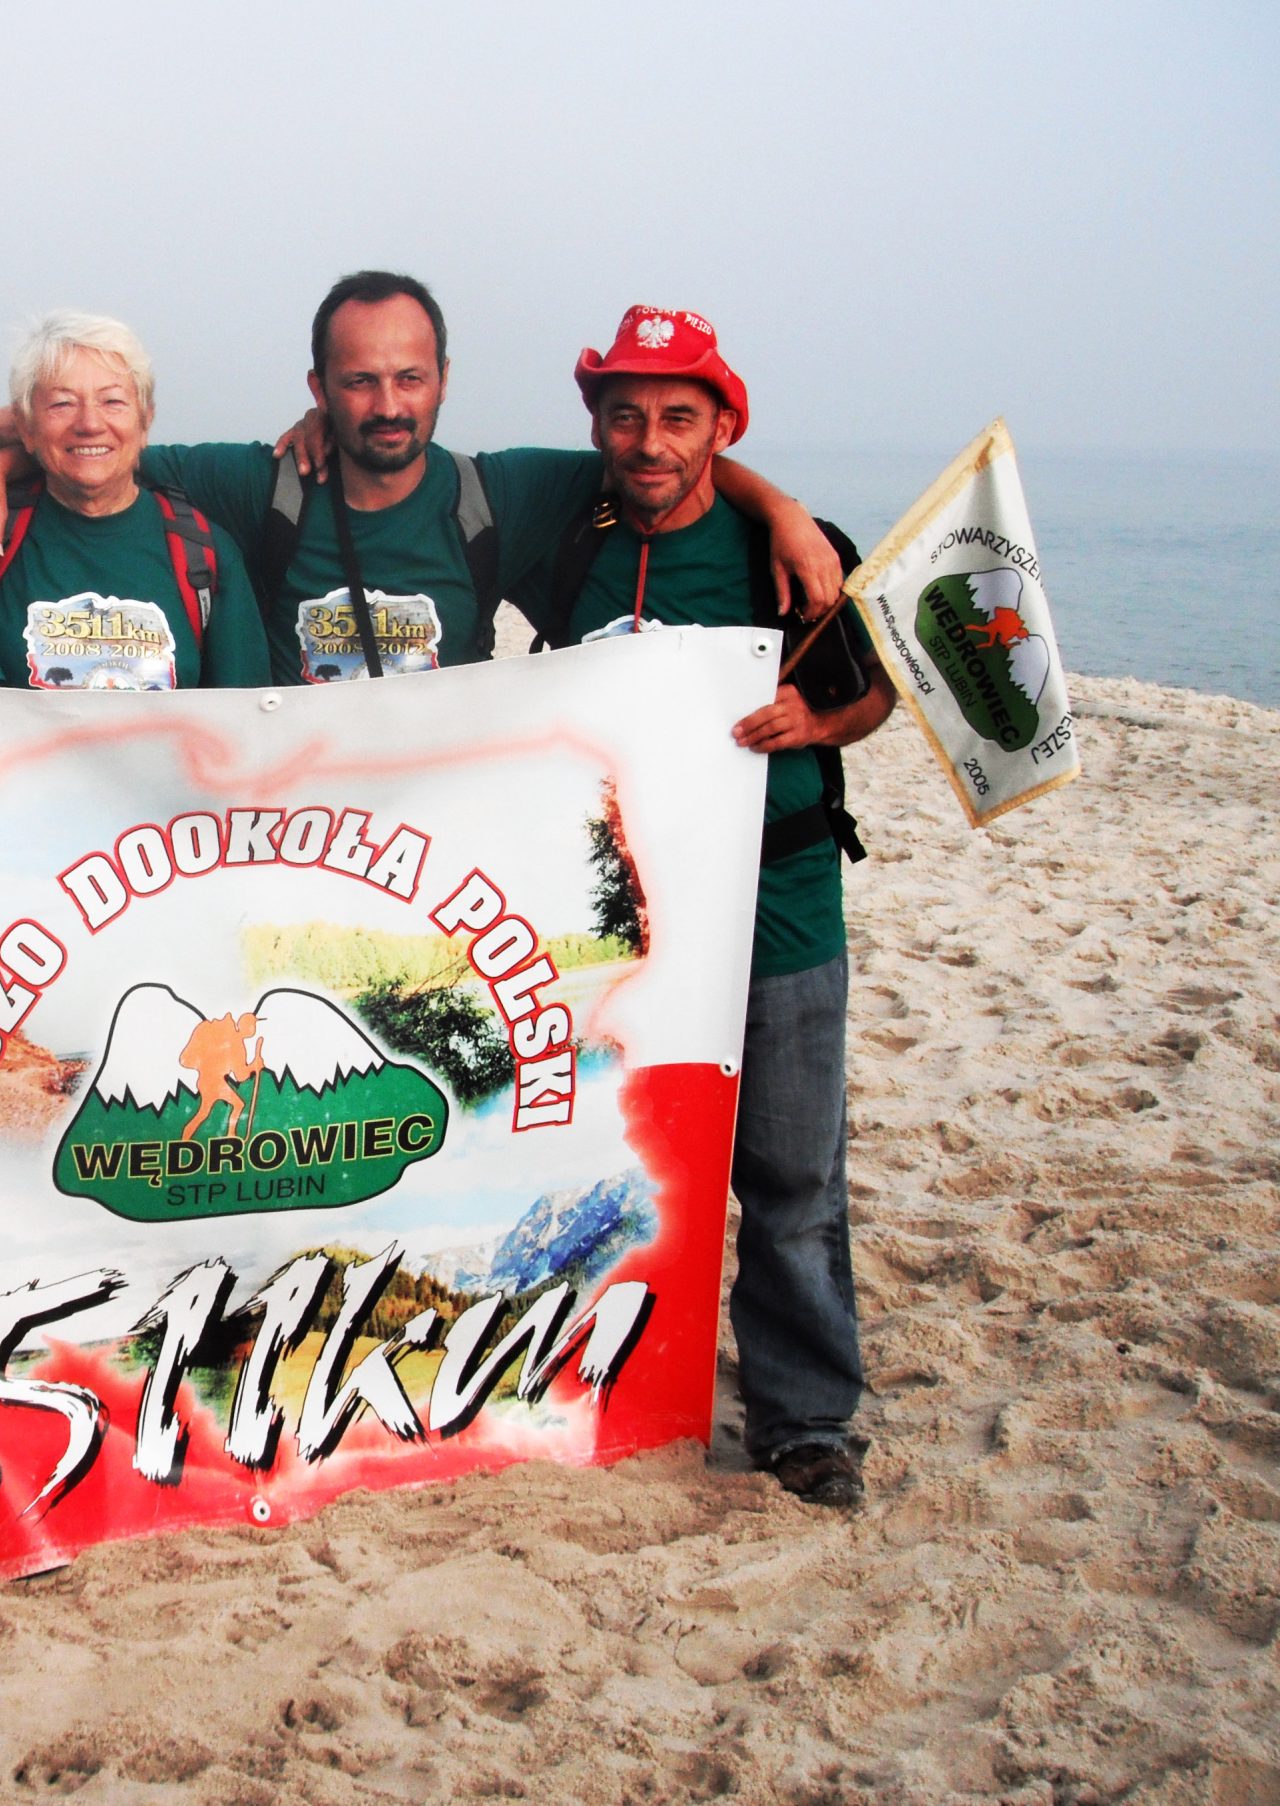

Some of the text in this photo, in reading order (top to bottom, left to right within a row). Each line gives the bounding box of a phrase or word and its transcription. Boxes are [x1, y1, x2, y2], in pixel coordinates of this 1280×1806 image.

[685, 312, 713, 335] PIESZO
[930, 527, 1042, 582] STOWARZYSZE
[40, 608, 162, 645] 3511km
[309, 604, 426, 639] 351km
[42, 641, 161, 660] 2008 2012
[376, 641, 427, 656] 2012
[929, 635, 977, 708] STP LUBIN
[1030, 712, 1073, 765] ESZEJ
[963, 757, 990, 796] 2005
[57, 806, 431, 934] DOOKOŁA
[428, 867, 576, 1132] POLSKI
[71, 1113, 435, 1187] WĘDROWIEC
[166, 1174, 326, 1207] STP LUBIN
